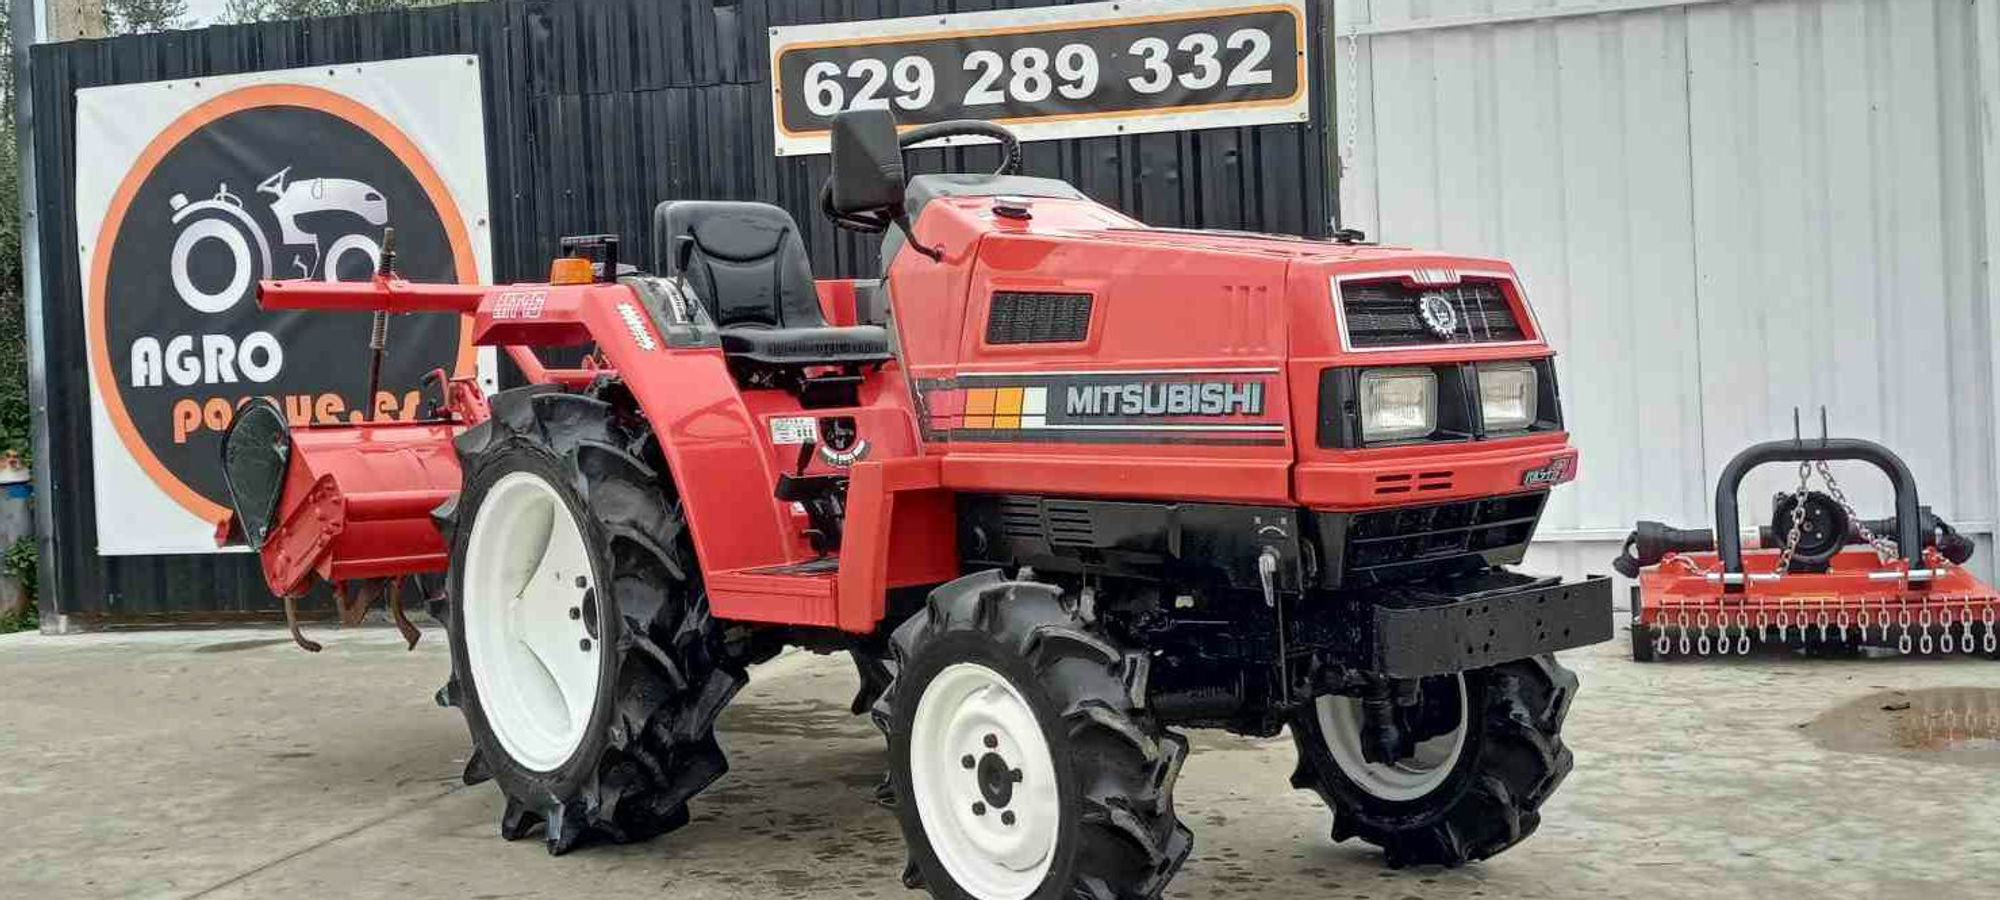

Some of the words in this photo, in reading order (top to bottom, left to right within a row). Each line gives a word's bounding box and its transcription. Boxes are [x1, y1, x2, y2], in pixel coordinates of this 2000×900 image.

[803, 55, 935, 116] 629
[962, 43, 1099, 105] 289
[1128, 27, 1273, 94] 332
[131, 331, 283, 387] AGRO
[173, 390, 420, 443] paue.es
[1066, 382, 1262, 416] MITSUBISHI
